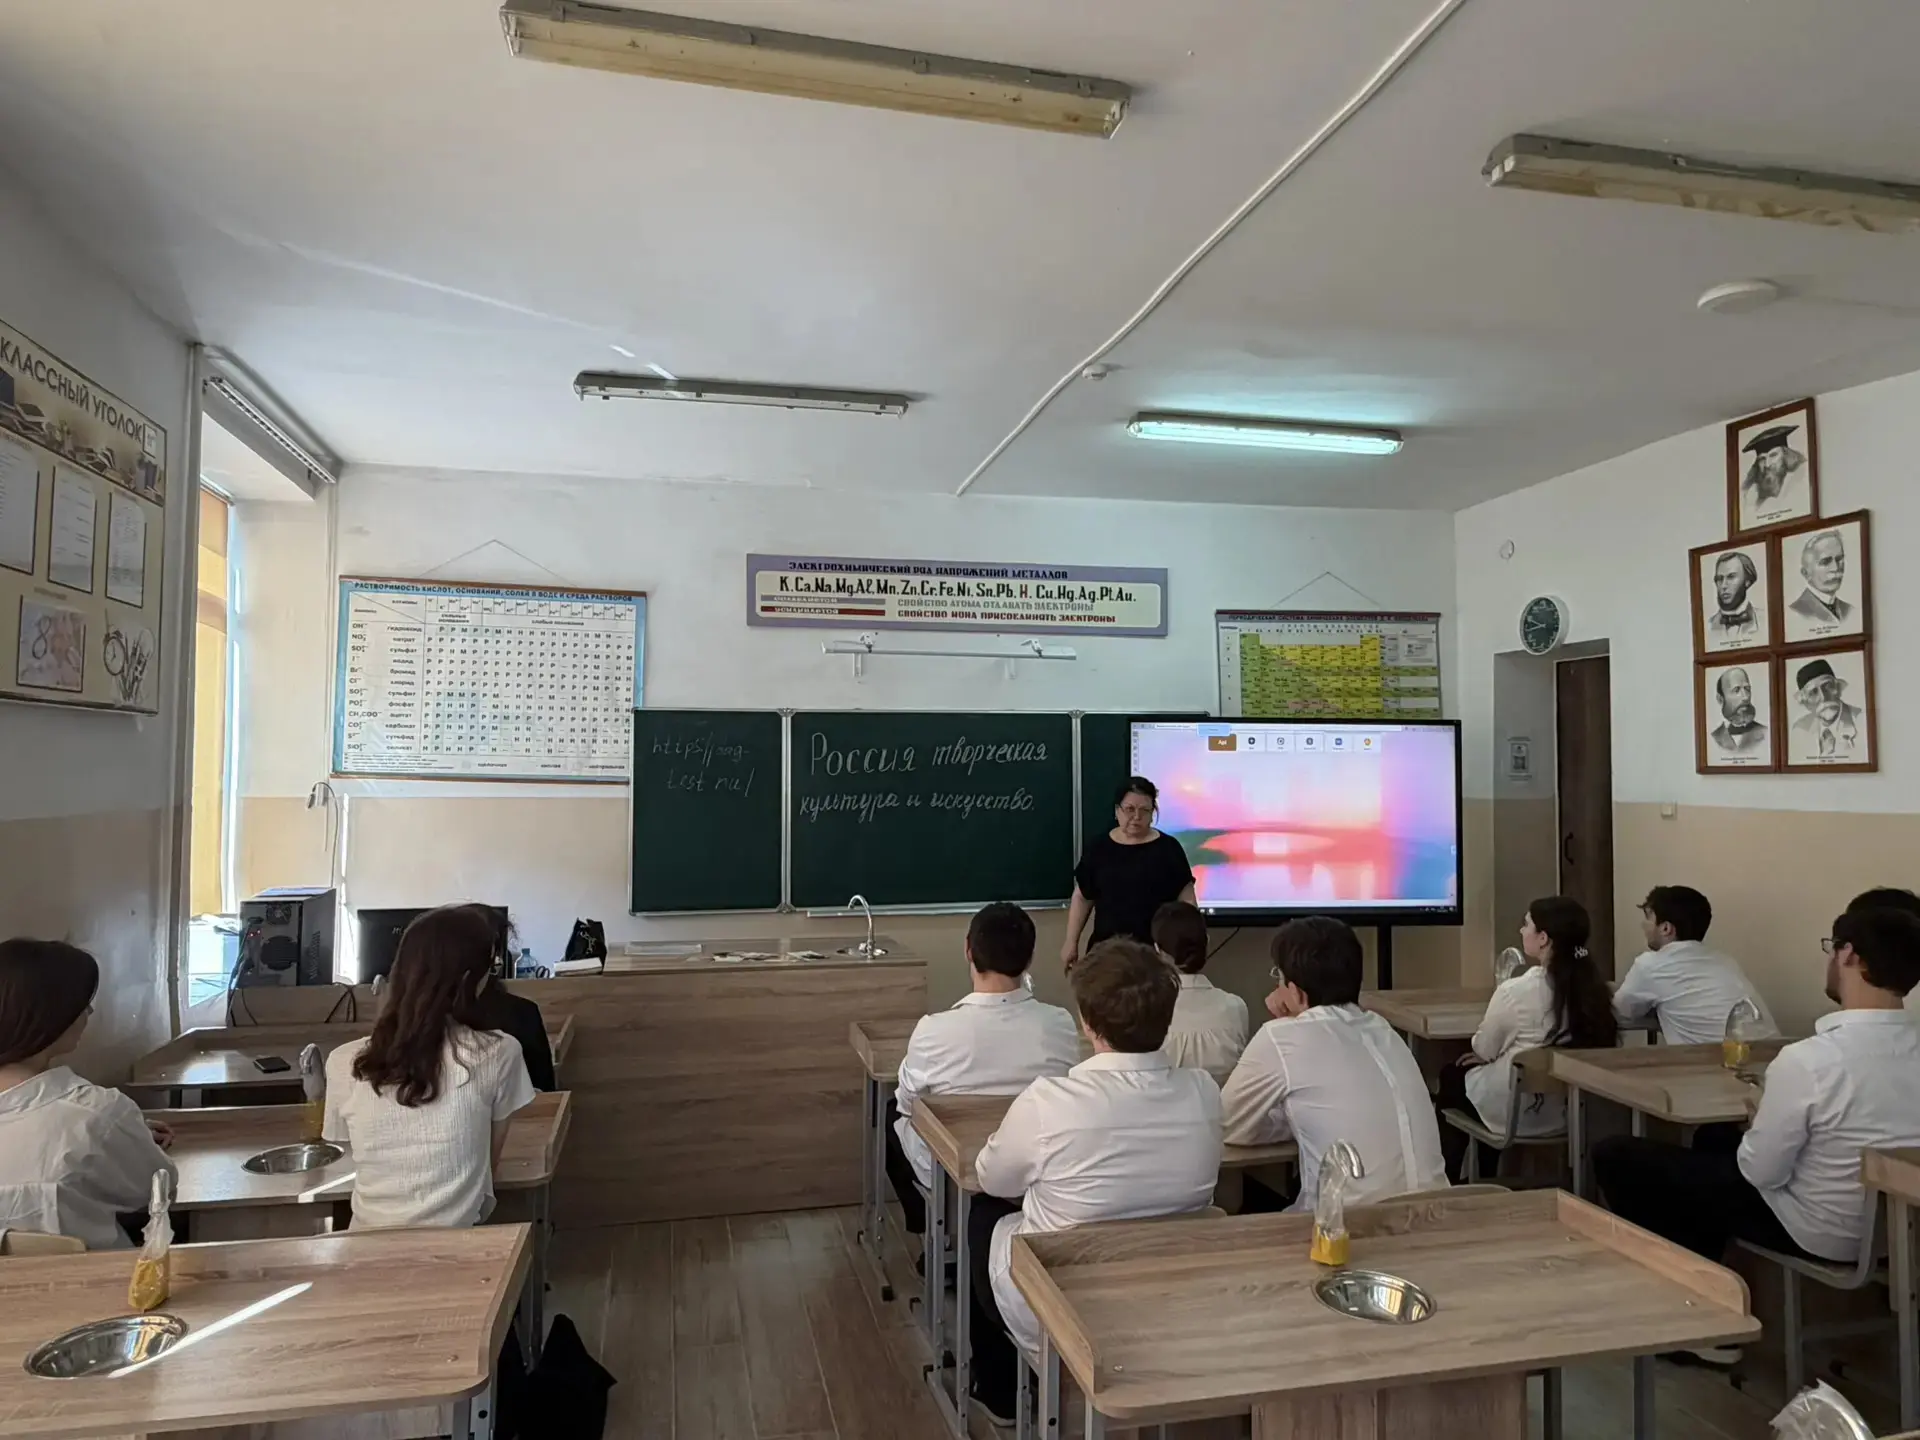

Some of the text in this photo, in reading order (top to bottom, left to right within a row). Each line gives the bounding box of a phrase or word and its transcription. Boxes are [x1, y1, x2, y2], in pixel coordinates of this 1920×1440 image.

[1, 336, 142, 442] КЛАССНЫЙ УГОЛОК
[354, 582, 420, 592] РАСТВОРИМОСТЬ
[1012, 570, 1068, 579] МЕТАЛЛОВ
[811, 732, 1048, 775] Россия творческая
[800, 793, 900, 823] культура
[906, 793, 921, 807] и
